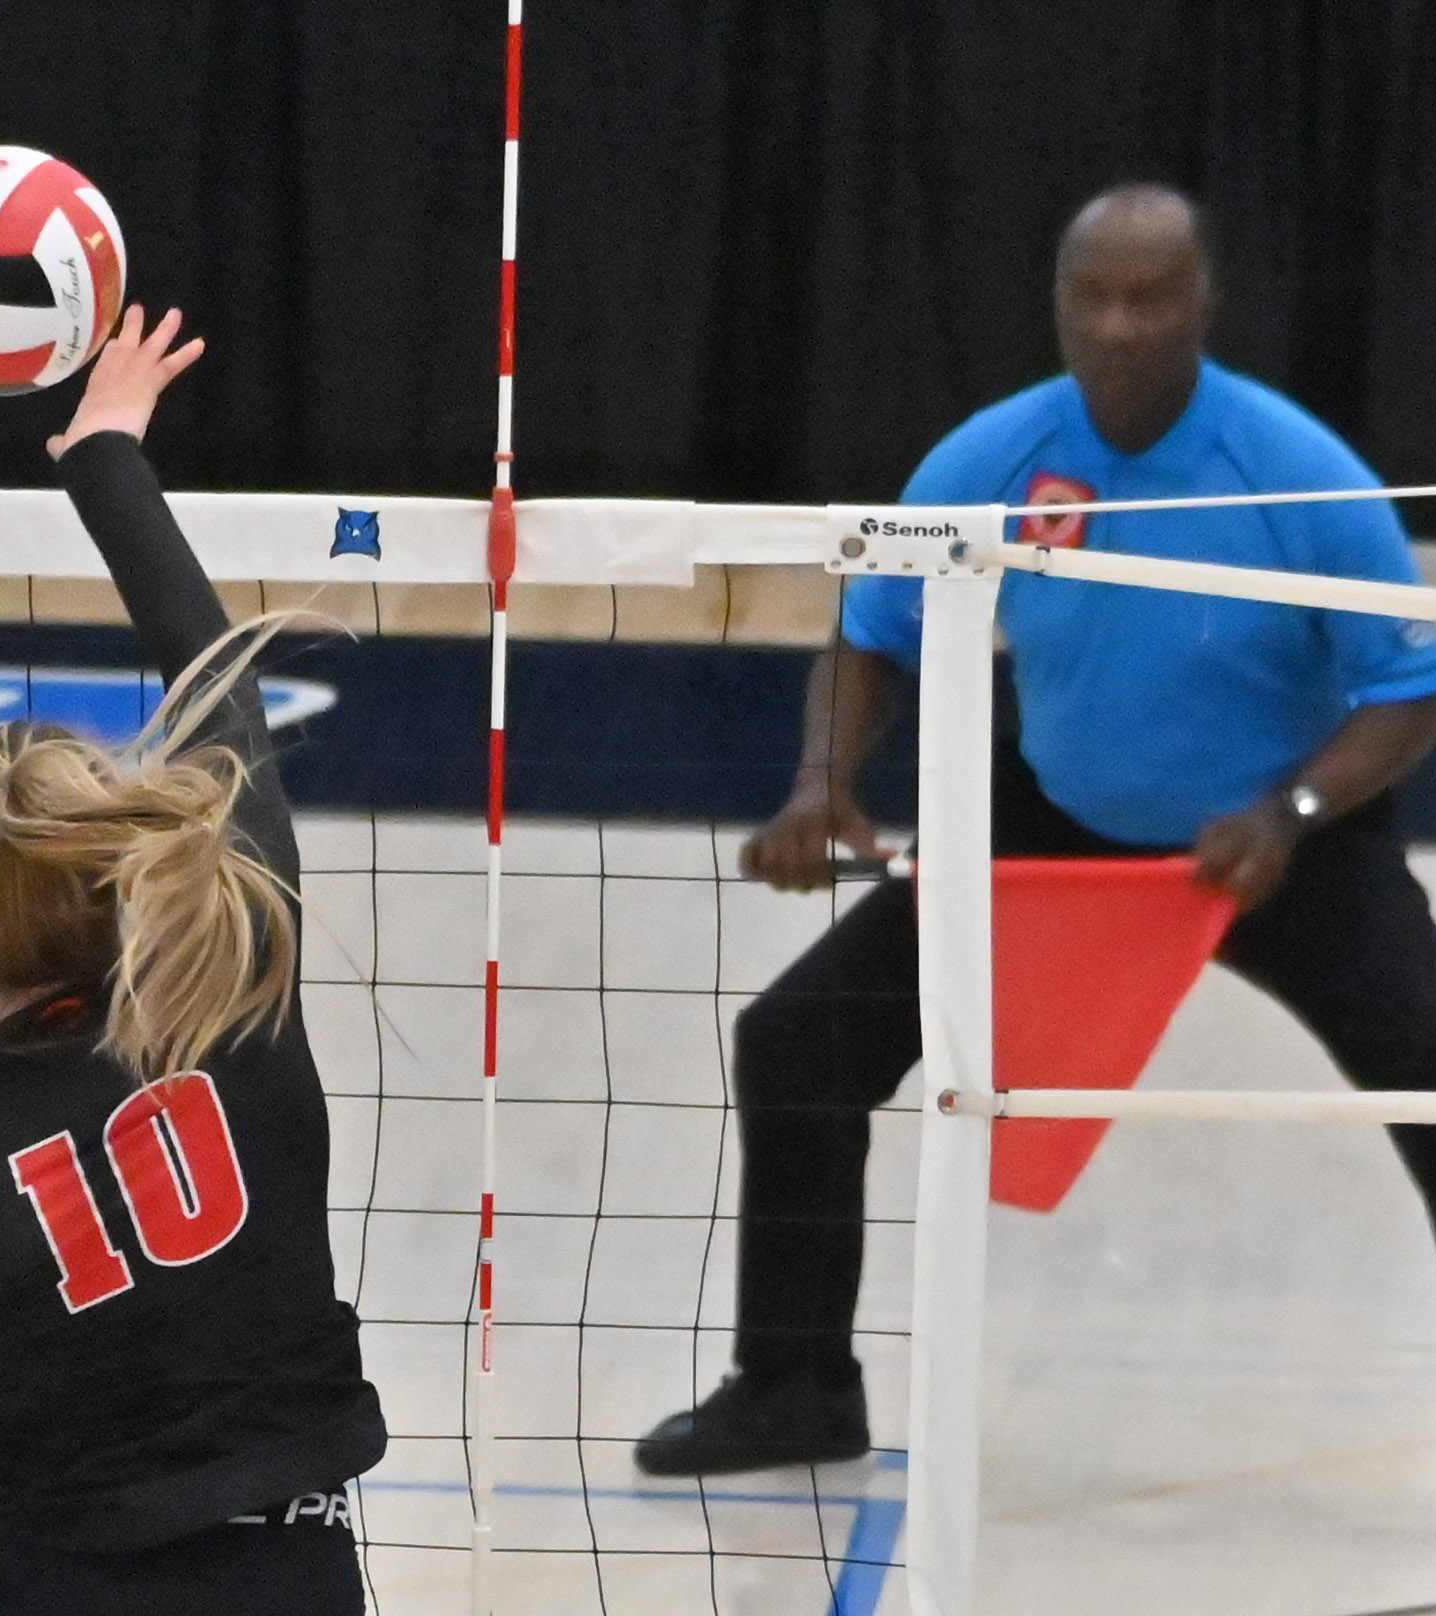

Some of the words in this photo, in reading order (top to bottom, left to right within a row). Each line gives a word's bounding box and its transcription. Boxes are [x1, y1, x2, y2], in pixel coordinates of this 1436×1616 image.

[57, 256, 81, 318] Touch
[881, 520, 959, 538] Senoh
[7, 1069, 249, 1315] 10
